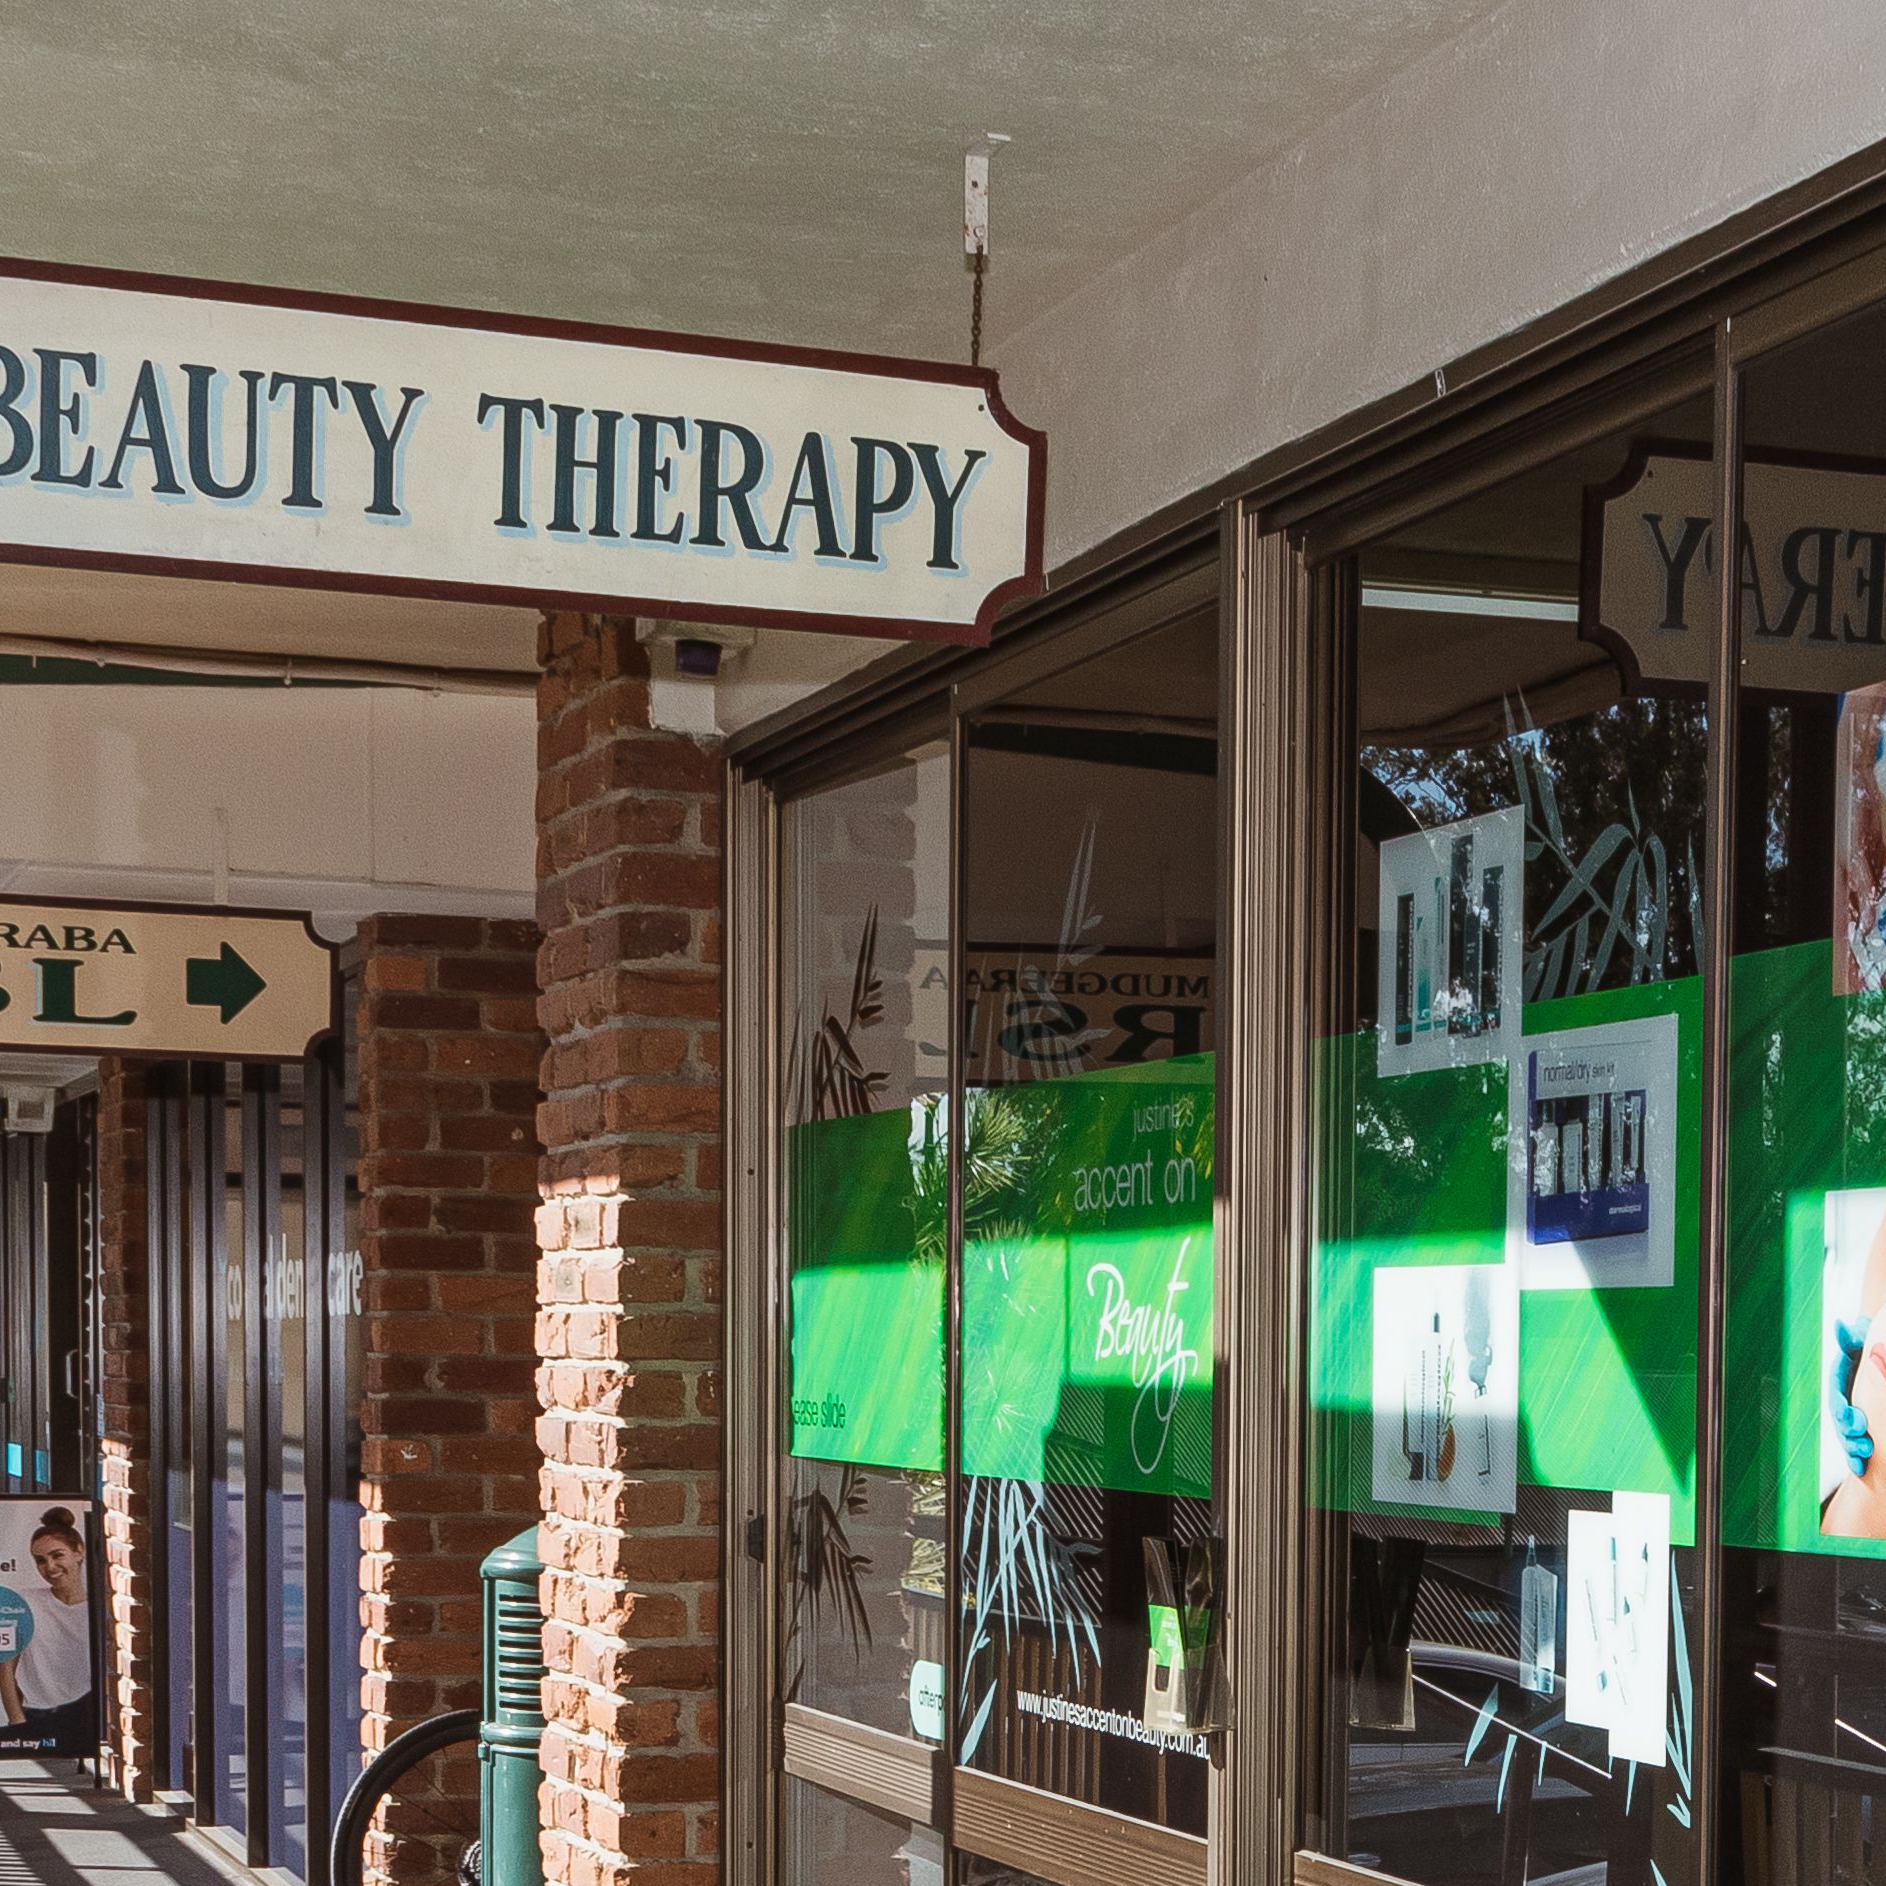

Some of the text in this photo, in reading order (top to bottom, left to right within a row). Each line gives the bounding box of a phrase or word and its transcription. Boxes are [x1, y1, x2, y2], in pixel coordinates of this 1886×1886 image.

[477, 394, 985, 572] THERAPY
[1074, 1150, 1196, 1211] accent on
[328, 1250, 363, 1317] care
[1086, 1237, 1198, 1474] Beauty
[1, 1738, 20, 1748] and
[23, 1740, 40, 1750] say
